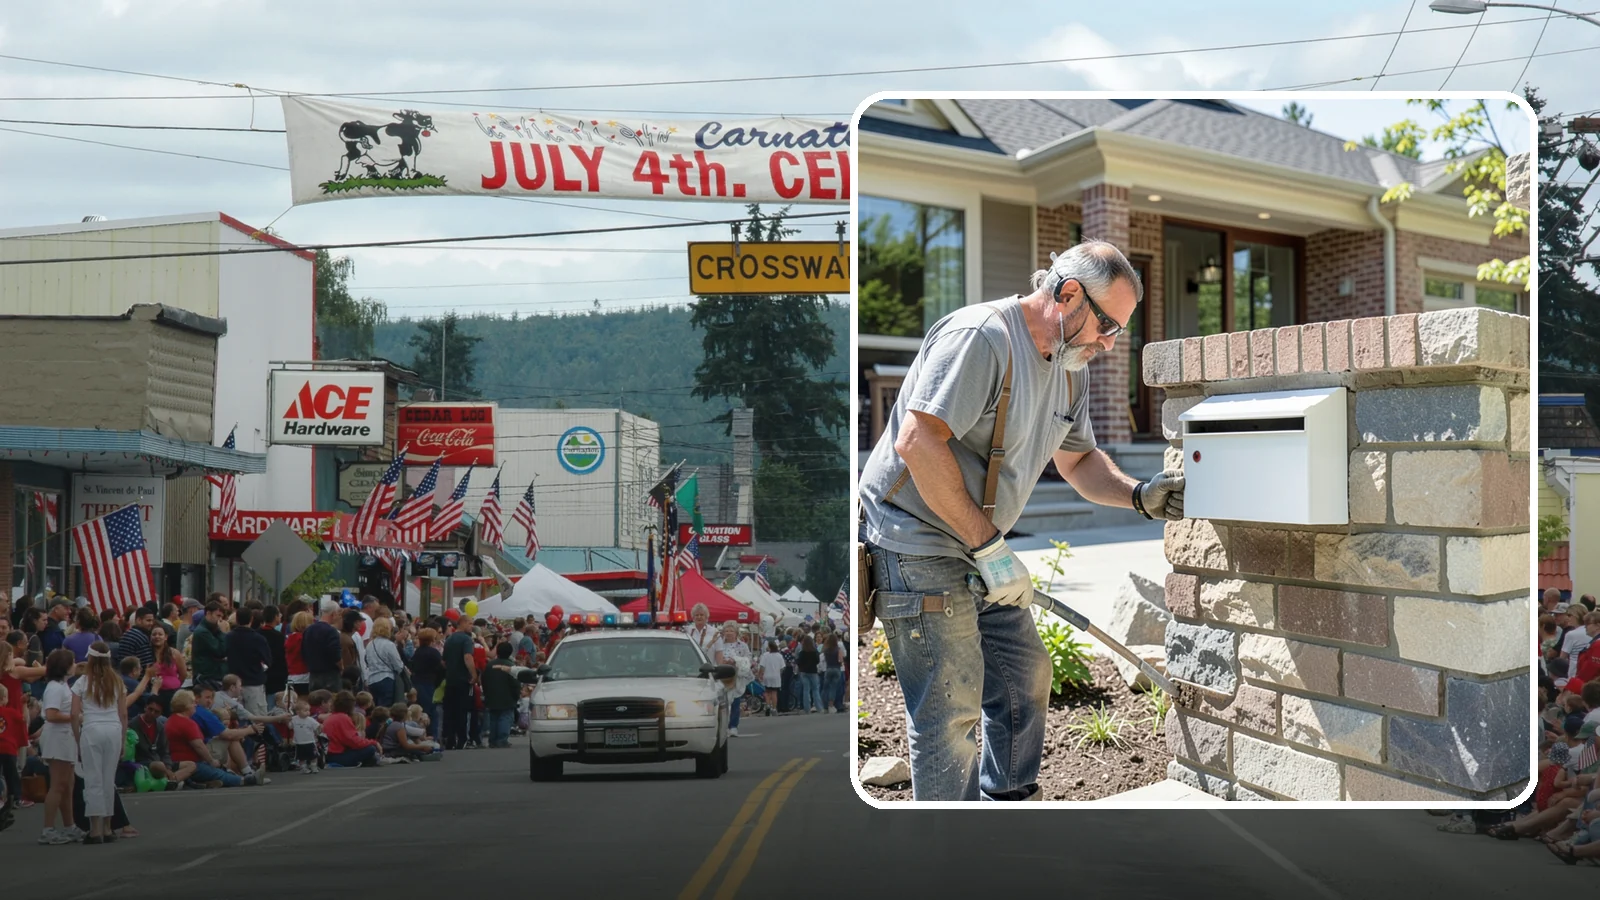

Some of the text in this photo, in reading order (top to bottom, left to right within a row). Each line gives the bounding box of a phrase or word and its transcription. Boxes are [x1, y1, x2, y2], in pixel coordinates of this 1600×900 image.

[481, 141, 605, 192] JULY
[632, 150, 746, 197] 4th.
[697, 254, 850, 280] CROSSWA
[283, 380, 373, 420] ACE
[406, 409, 485, 422] CEDAR LOG
[283, 421, 370, 436] Hardware
[416, 428, 477, 447] Coca-Cola
[84, 485, 155, 495] St. Vincent de Paul
[688, 526, 741, 535] CRNATION
[699, 535, 730, 544] GLASS
